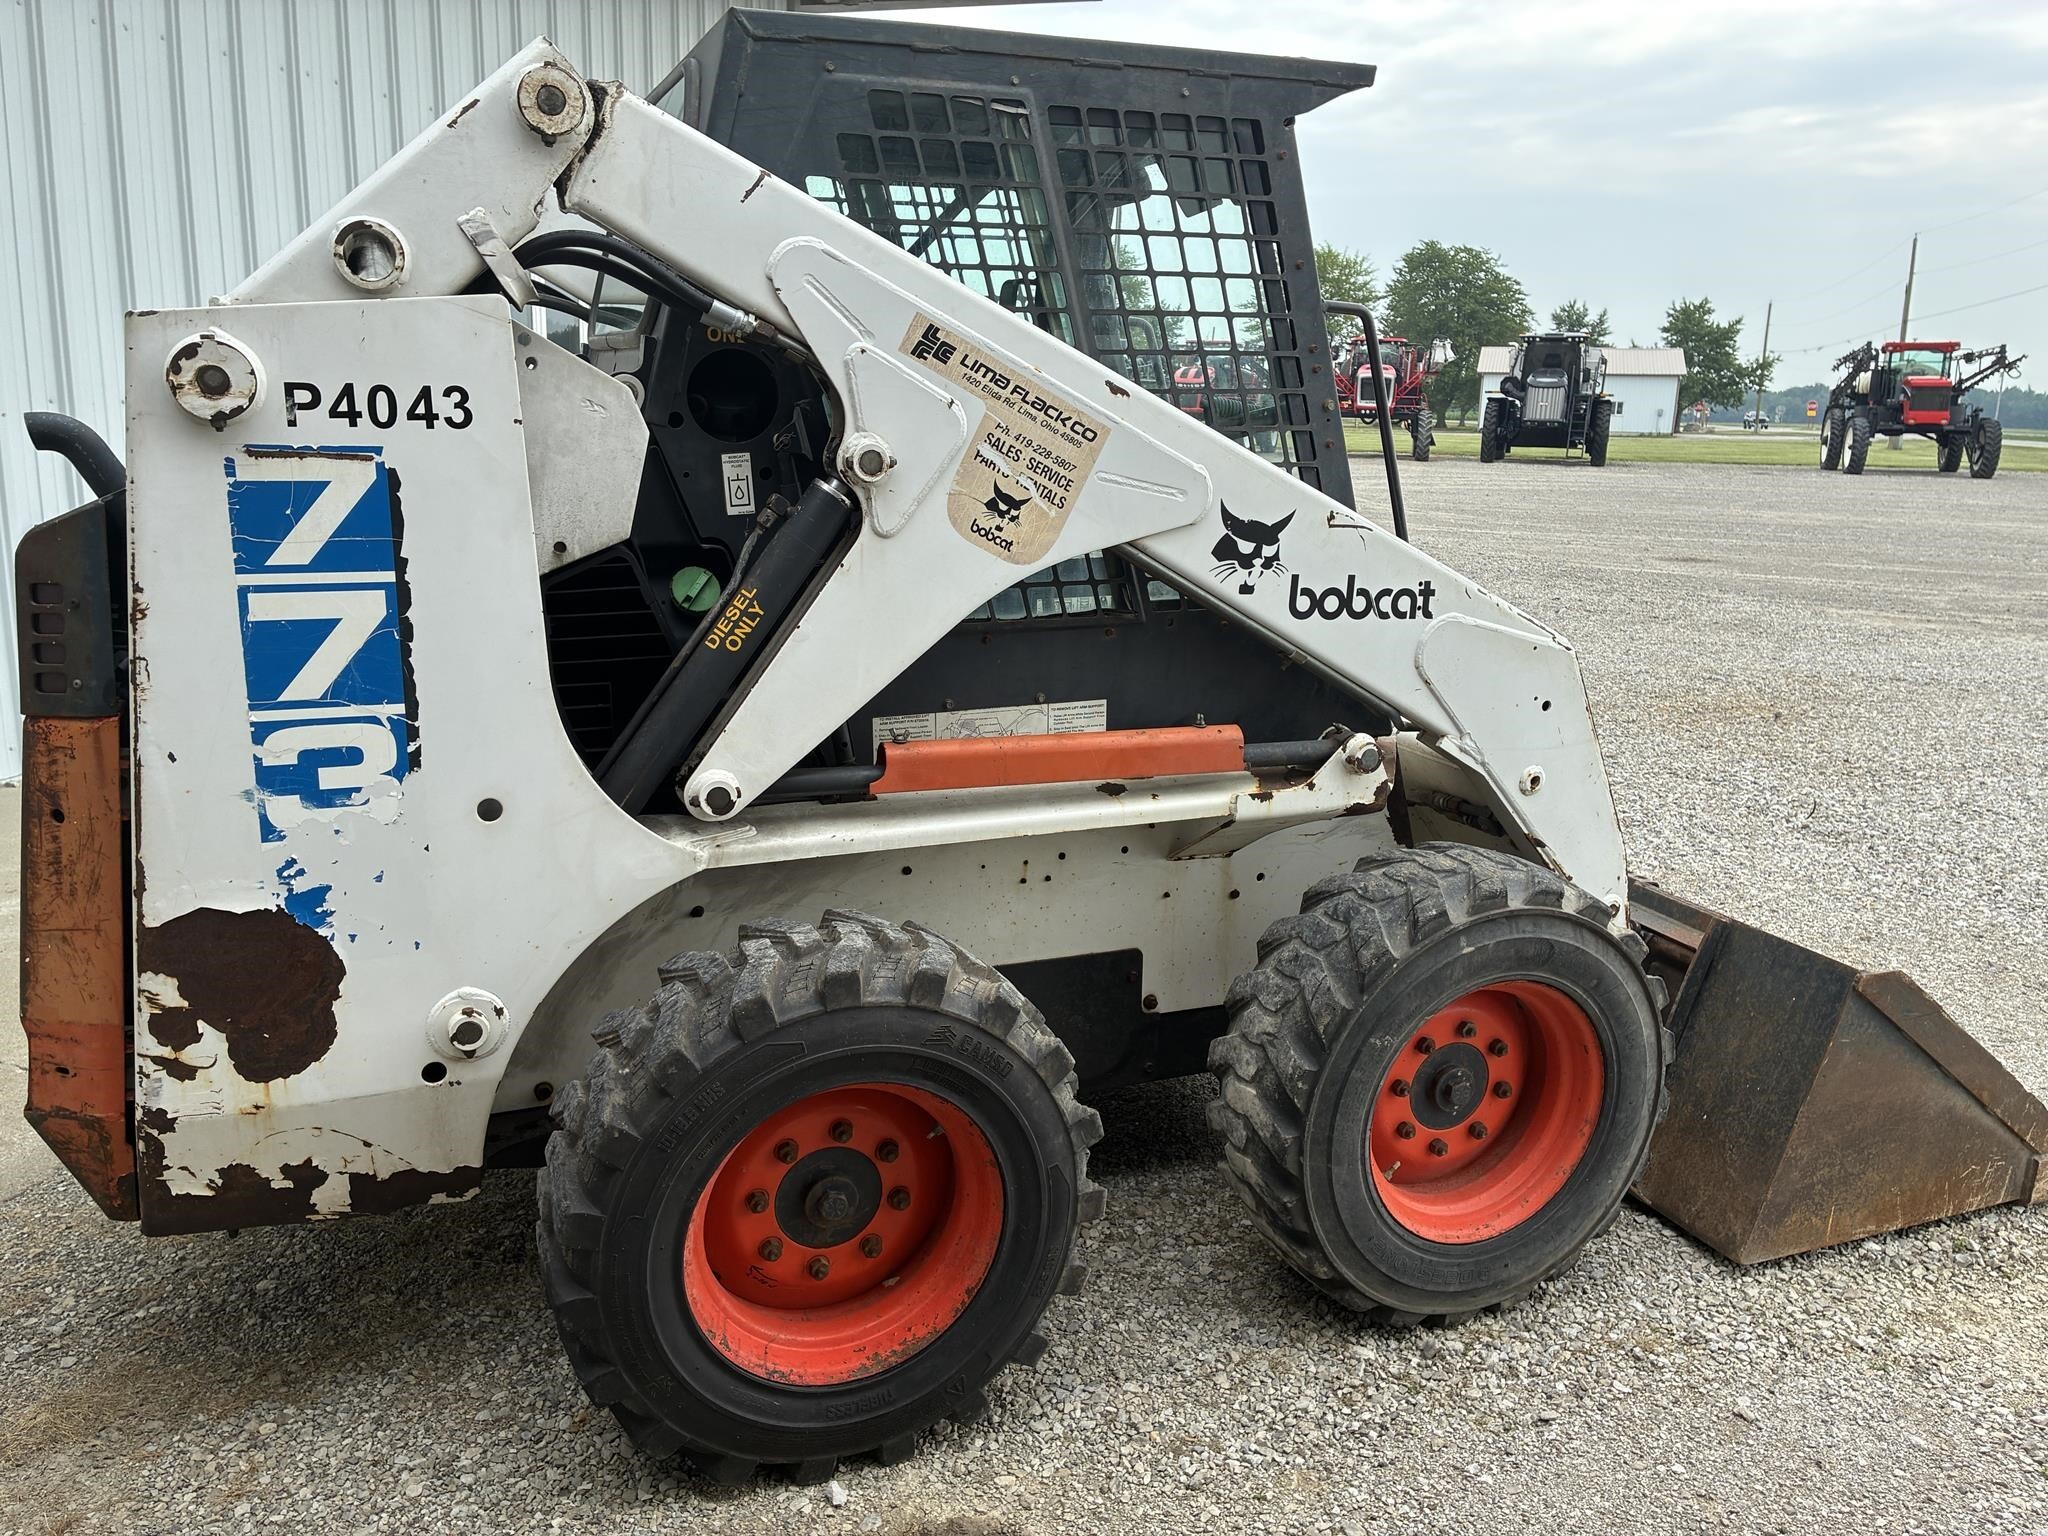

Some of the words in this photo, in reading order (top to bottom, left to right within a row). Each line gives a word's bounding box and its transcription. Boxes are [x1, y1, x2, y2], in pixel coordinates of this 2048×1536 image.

[283, 381, 474, 430] P4043
[960, 353, 1010, 390] LIMA
[1009, 384, 1072, 427] FLACK
[1069, 420, 1098, 442] CO
[961, 373, 981, 388] 1420
[981, 384, 1002, 401] Elida
[1002, 397, 1015, 410] Rd.
[1017, 406, 1038, 424] Lima,
[1040, 419, 1060, 435] Ohio
[1060, 431, 1084, 449] 45805
[984, 432, 1022, 463] SALES
[1026, 457, 1075, 493] SERVICE
[994, 422, 1010, 437] Ph.
[1013, 433, 1078, 473] 419-228-5807
[969, 518, 1014, 553] bobcat
[704, 588, 757, 649] DIESEL
[1288, 573, 1436, 620] bobcat
[236, 458, 404, 828] 773
[725, 600, 765, 652] ONLY
